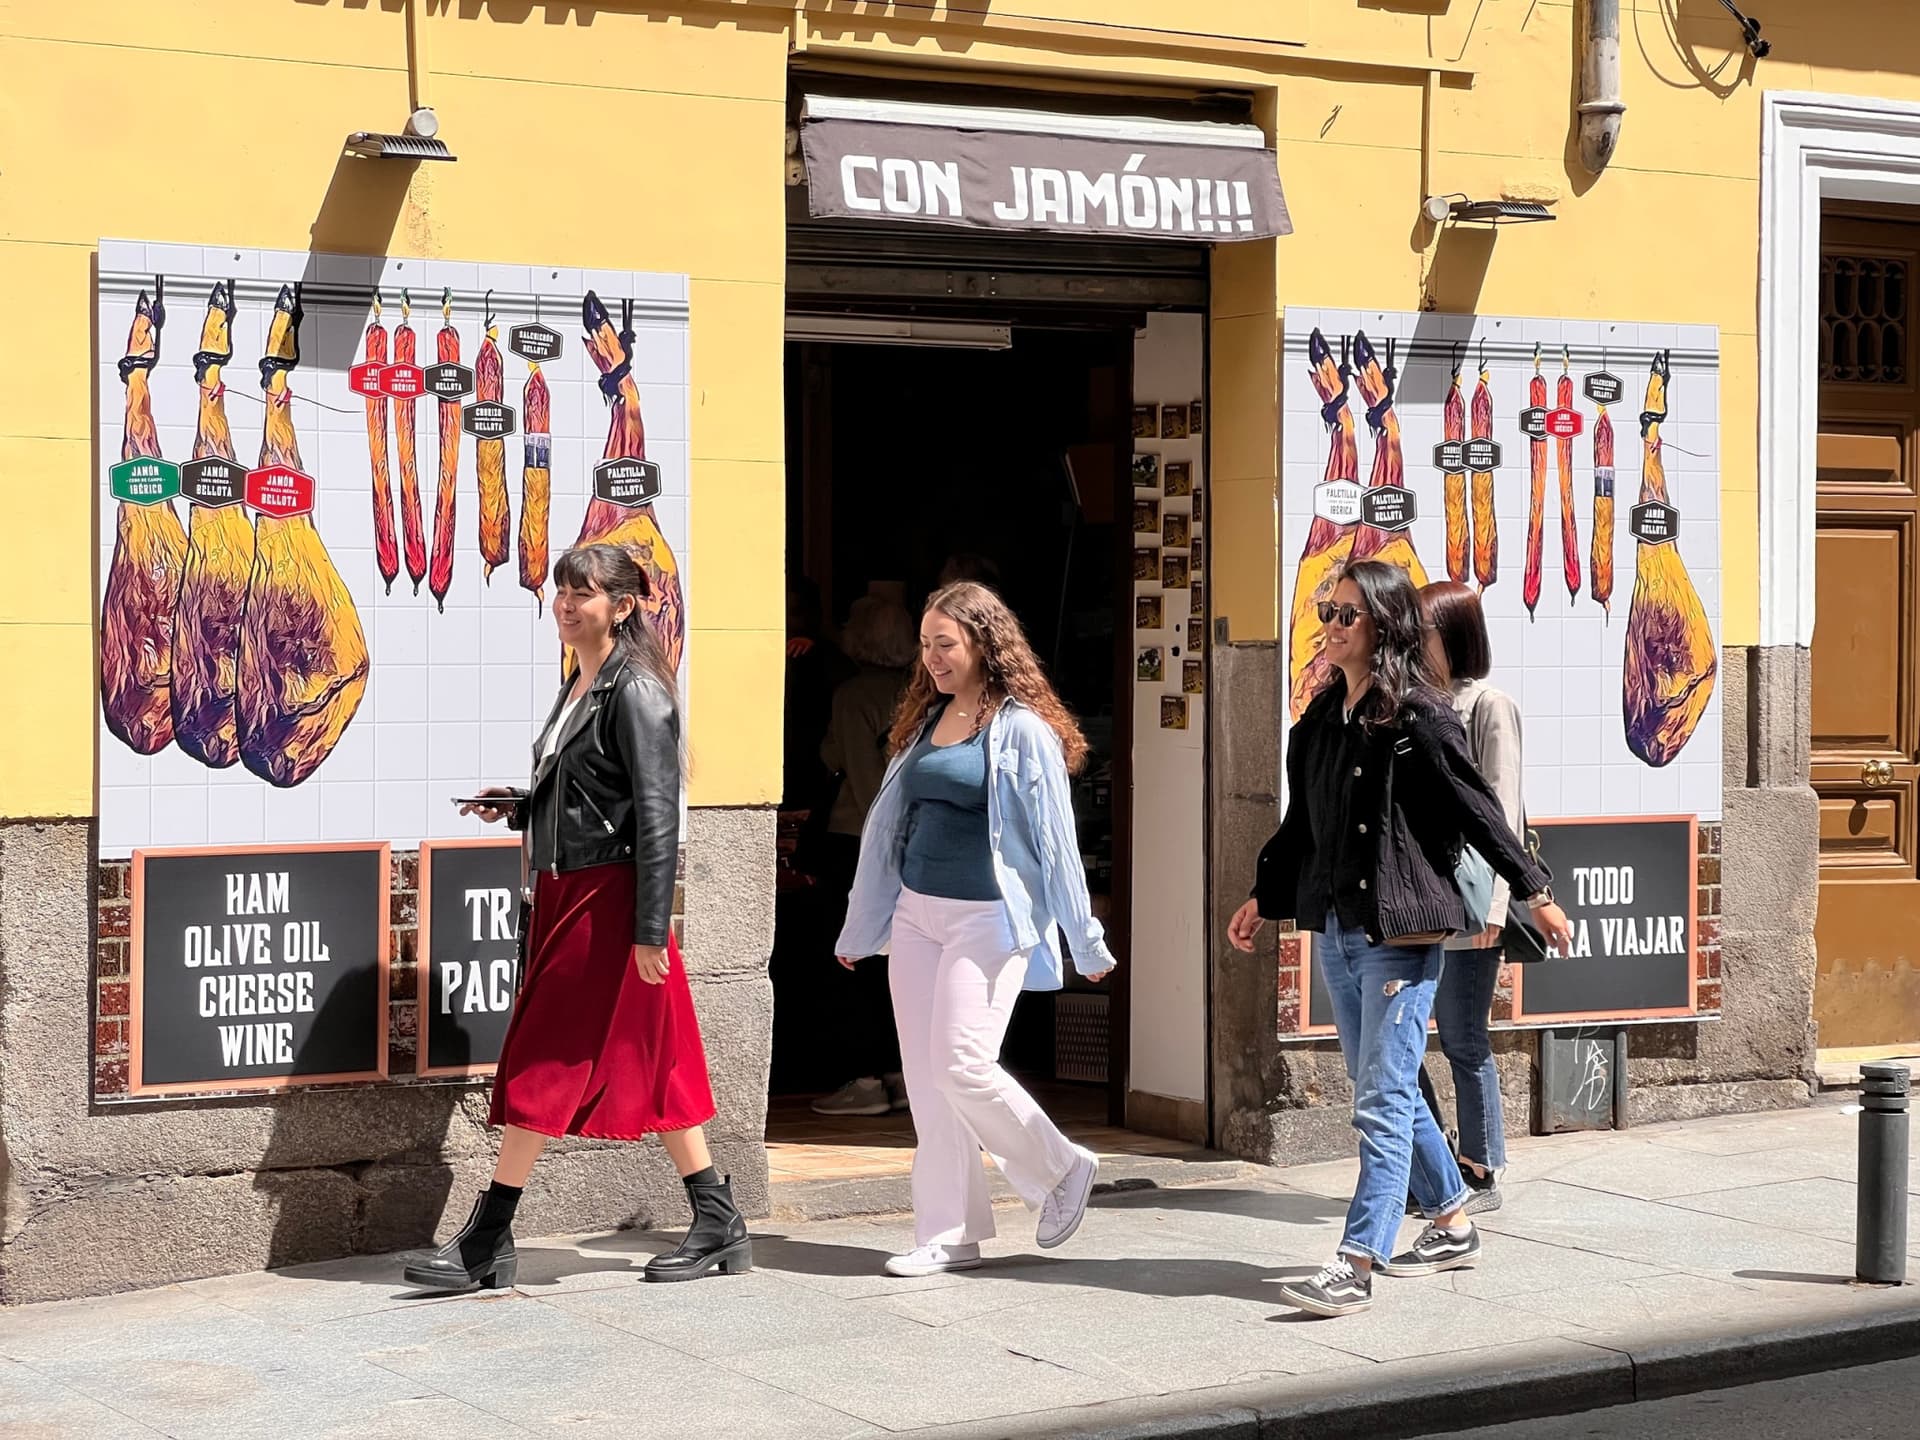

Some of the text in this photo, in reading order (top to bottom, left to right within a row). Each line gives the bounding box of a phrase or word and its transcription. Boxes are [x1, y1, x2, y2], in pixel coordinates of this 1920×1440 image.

[840, 153, 1255, 232] CON JAMÓN!!!
[522, 344, 548, 356] BELLOTA
[440, 369, 458, 377] LOMO
[363, 381, 378, 391] IBÉR
[435, 382, 463, 391] BELLOTA
[475, 408, 502, 417] CHORIZO
[474, 422, 503, 431] BELLOTA
[1469, 456, 1492, 465] BELLOTA
[131, 464, 160, 477] JAMÓN
[201, 464, 230, 478] JAMÓN
[607, 466, 646, 479] PALETILLA
[266, 474, 294, 488] JAMÓN
[129, 482, 163, 495] IBÉRICO
[196, 484, 232, 498] BELLOTA
[610, 484, 645, 497] BELLOTA
[1326, 488, 1358, 499] PALETILLA
[261, 493, 297, 507] BELLOTA
[1372, 493, 1405, 505] PALETILLA
[1330, 503, 1353, 515] IBÉRICA
[1644, 507, 1666, 519] JAMÓN
[1375, 510, 1404, 522] BELLOTA
[1641, 524, 1668, 535] BELLOTA
[1573, 866, 1634, 906] TODO
[225, 872, 290, 916] HAM
[464, 887, 521, 941] TR
[1600, 915, 1686, 957] VIAJAR
[184, 921, 331, 968] OLIVE OIL
[199, 972, 315, 1018] CHEESE
[218, 1022, 295, 1067] WINE
